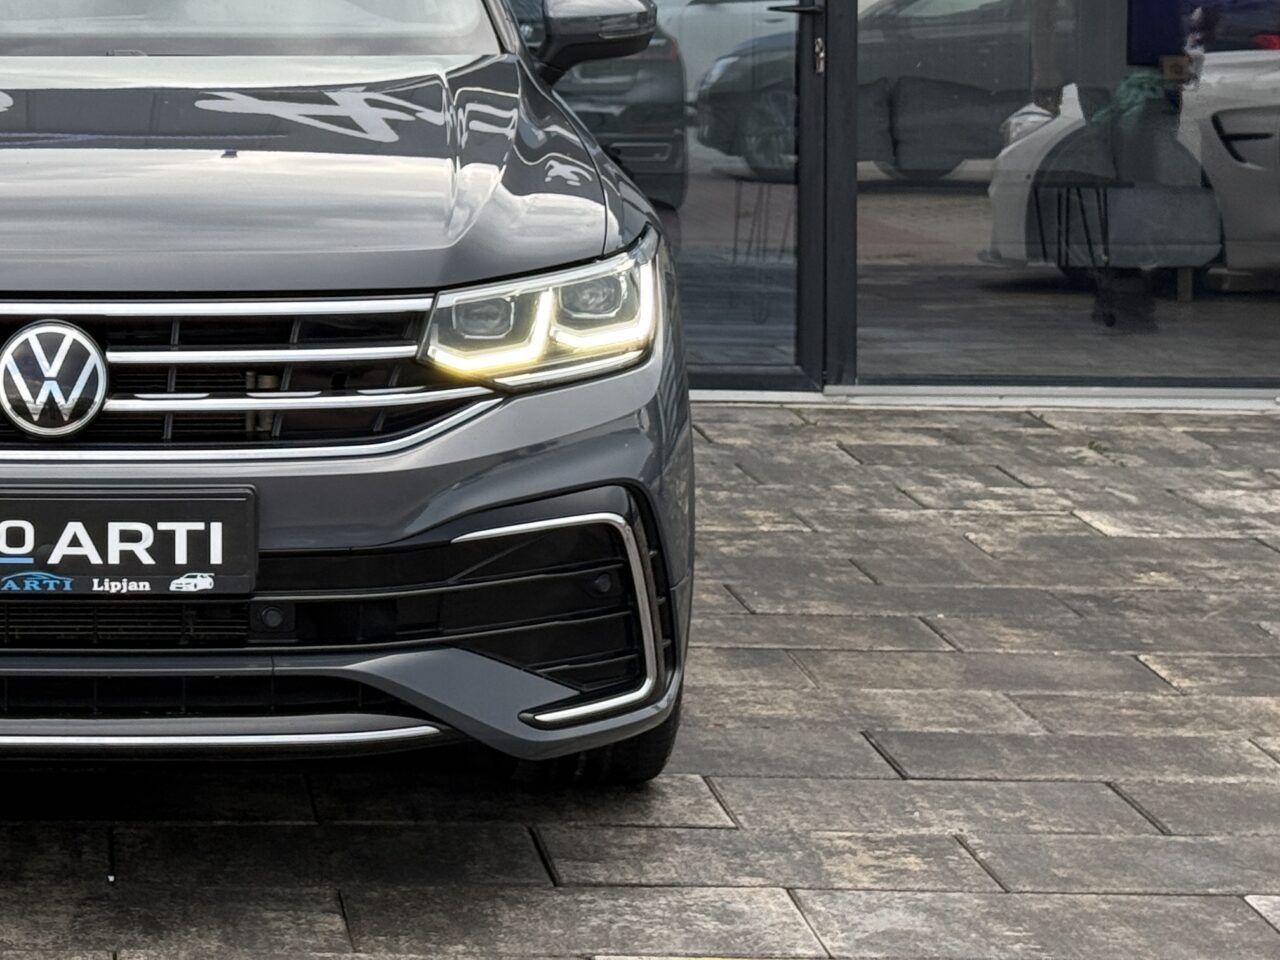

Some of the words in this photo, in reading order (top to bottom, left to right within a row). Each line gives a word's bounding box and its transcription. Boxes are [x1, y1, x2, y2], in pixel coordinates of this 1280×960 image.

[47, 521, 223, 565] ARTI
[0, 578, 74, 591] ARTI
[92, 577, 152, 594] Lipjan
